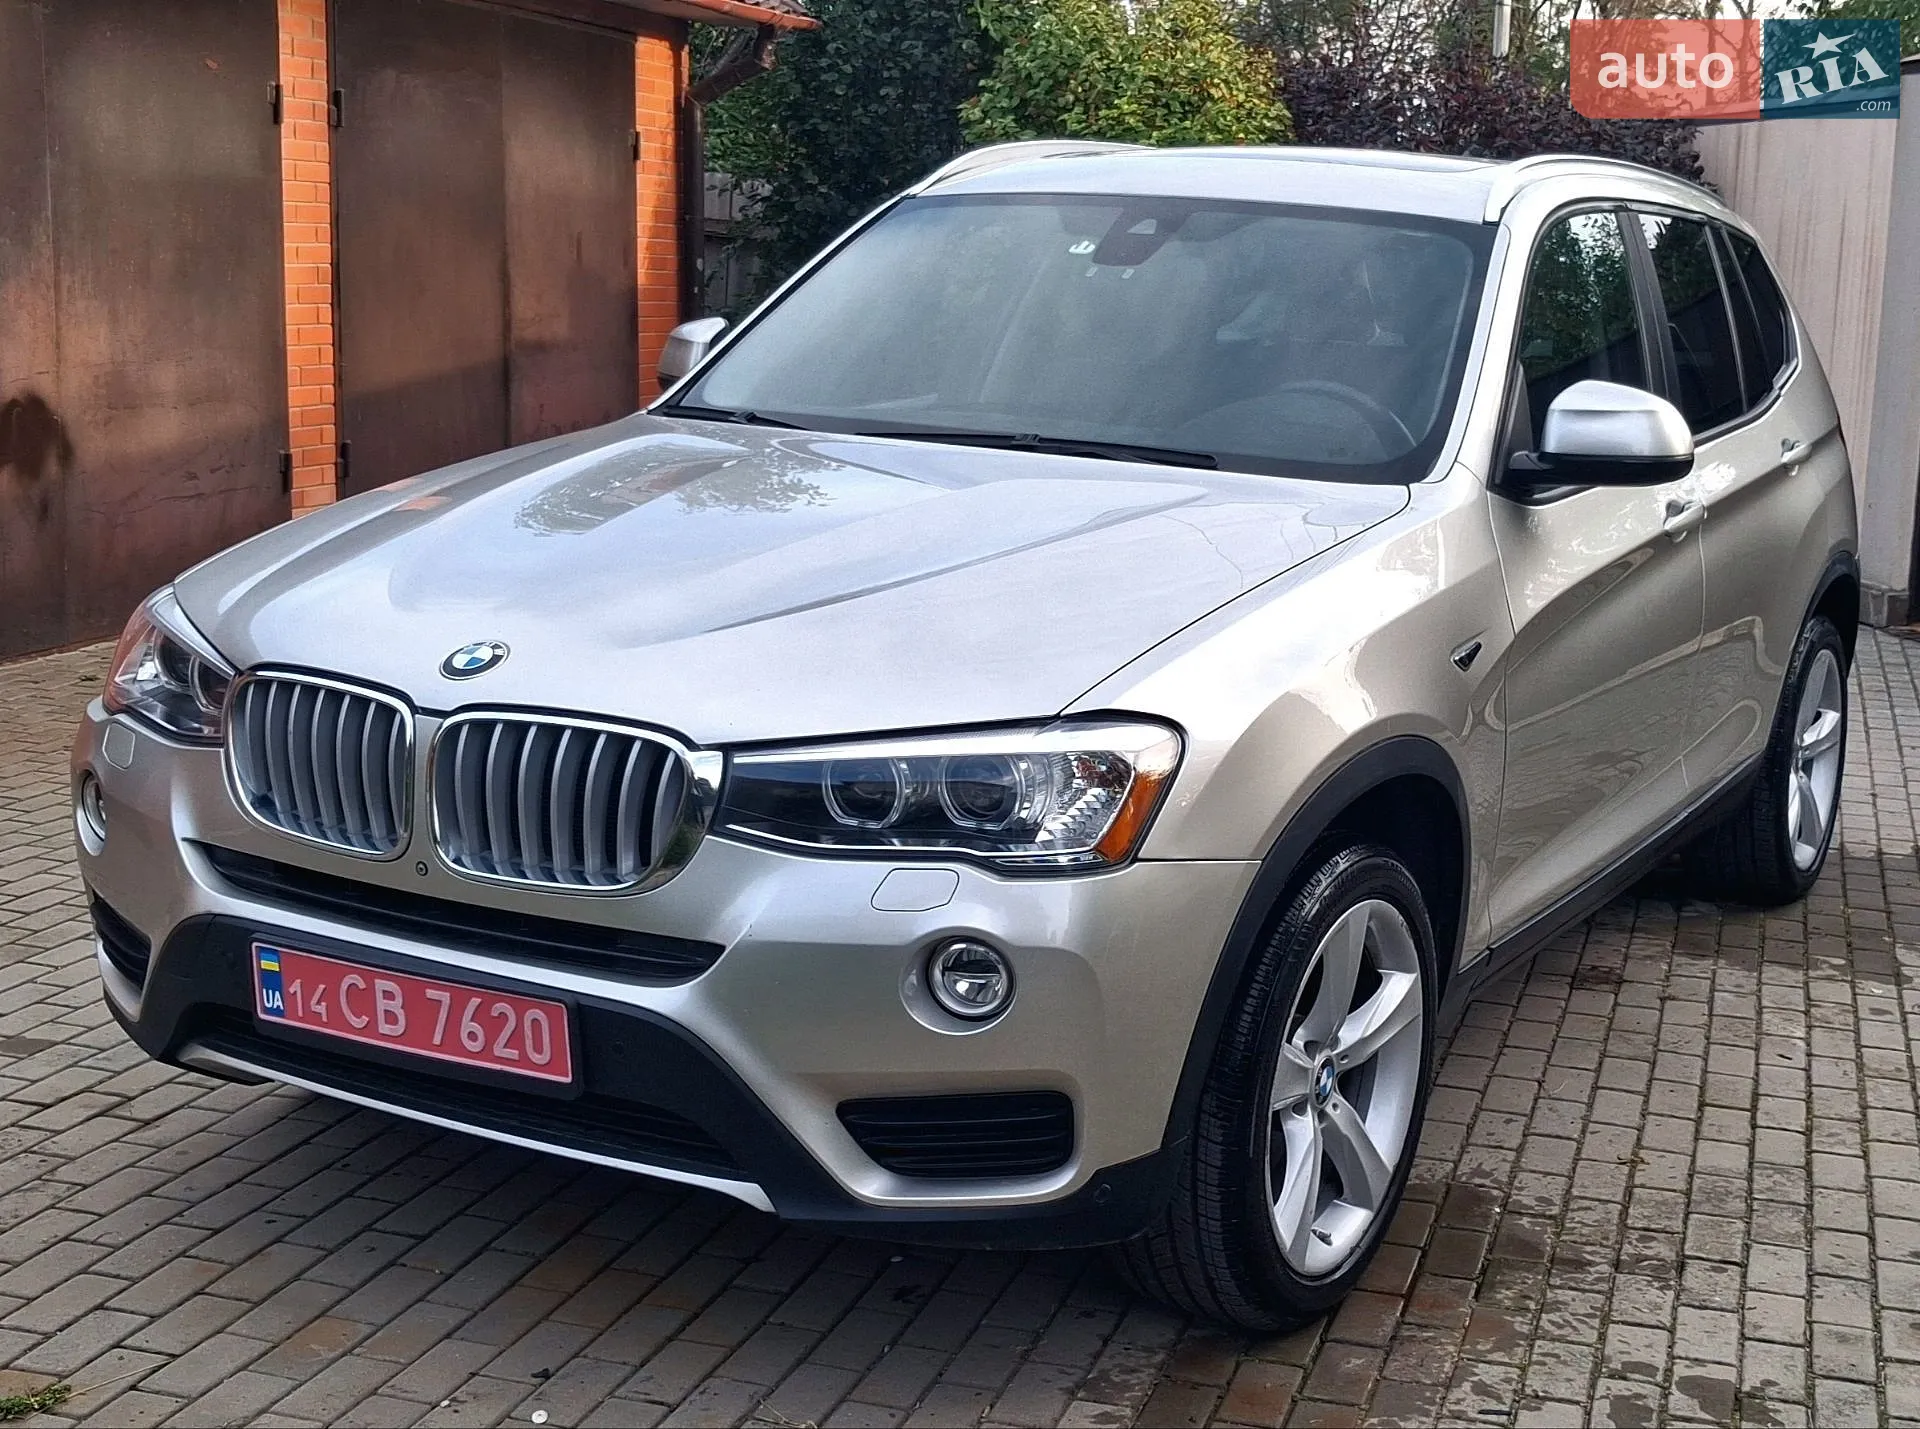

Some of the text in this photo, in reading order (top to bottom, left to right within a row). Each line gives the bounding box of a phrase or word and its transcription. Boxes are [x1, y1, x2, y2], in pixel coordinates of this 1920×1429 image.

[262, 988, 284, 1010] UA
[288, 974, 551, 1065] 14 CB 7620
